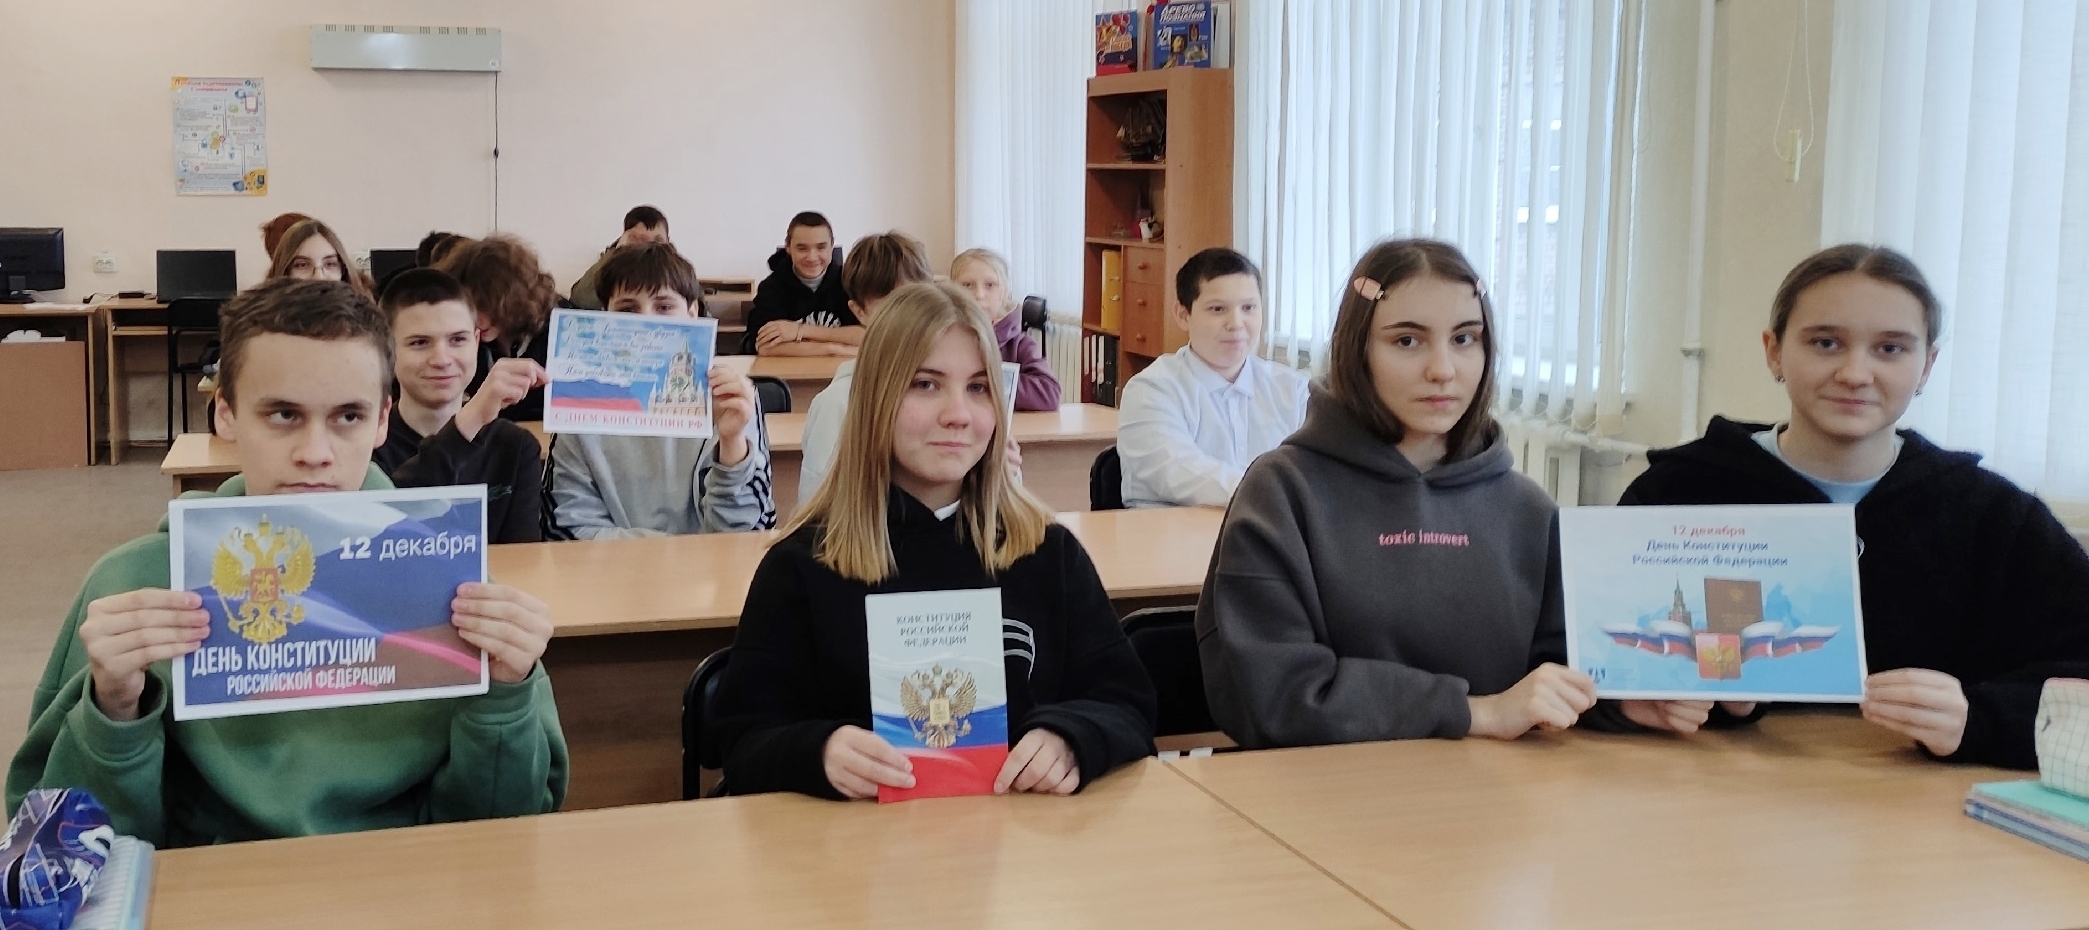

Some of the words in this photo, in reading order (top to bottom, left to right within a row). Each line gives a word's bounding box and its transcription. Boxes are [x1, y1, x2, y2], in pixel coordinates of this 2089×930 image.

[603, 416, 684, 429] КОНСТИТУЦИИ
[688, 419, 703, 429] РФ
[1378, 529, 1416, 546] toxic
[1418, 528, 1470, 547] introvert
[1671, 525, 1688, 536] 12
[1690, 525, 1746, 537] декабря
[339, 536, 372, 561] 12
[379, 532, 477, 561] декабря
[1646, 540, 1680, 553] День
[1682, 540, 1769, 553] Конституции
[1632, 553, 1709, 566] Российской
[1712, 554, 1789, 569] Федерации
[897, 611, 972, 625] КОНСТИТУЦИЯ
[900, 622, 969, 636] РОССИЙСКОЙ
[904, 637, 967, 648] ФЕДЕРАЦИИ
[191, 646, 242, 677] ДЕНЬ
[247, 637, 377, 671] КОНСТИТУЦИИ
[226, 667, 313, 696] РОССИЙСКОЙ
[315, 664, 397, 689] ФЕДЕРАЦИИ
